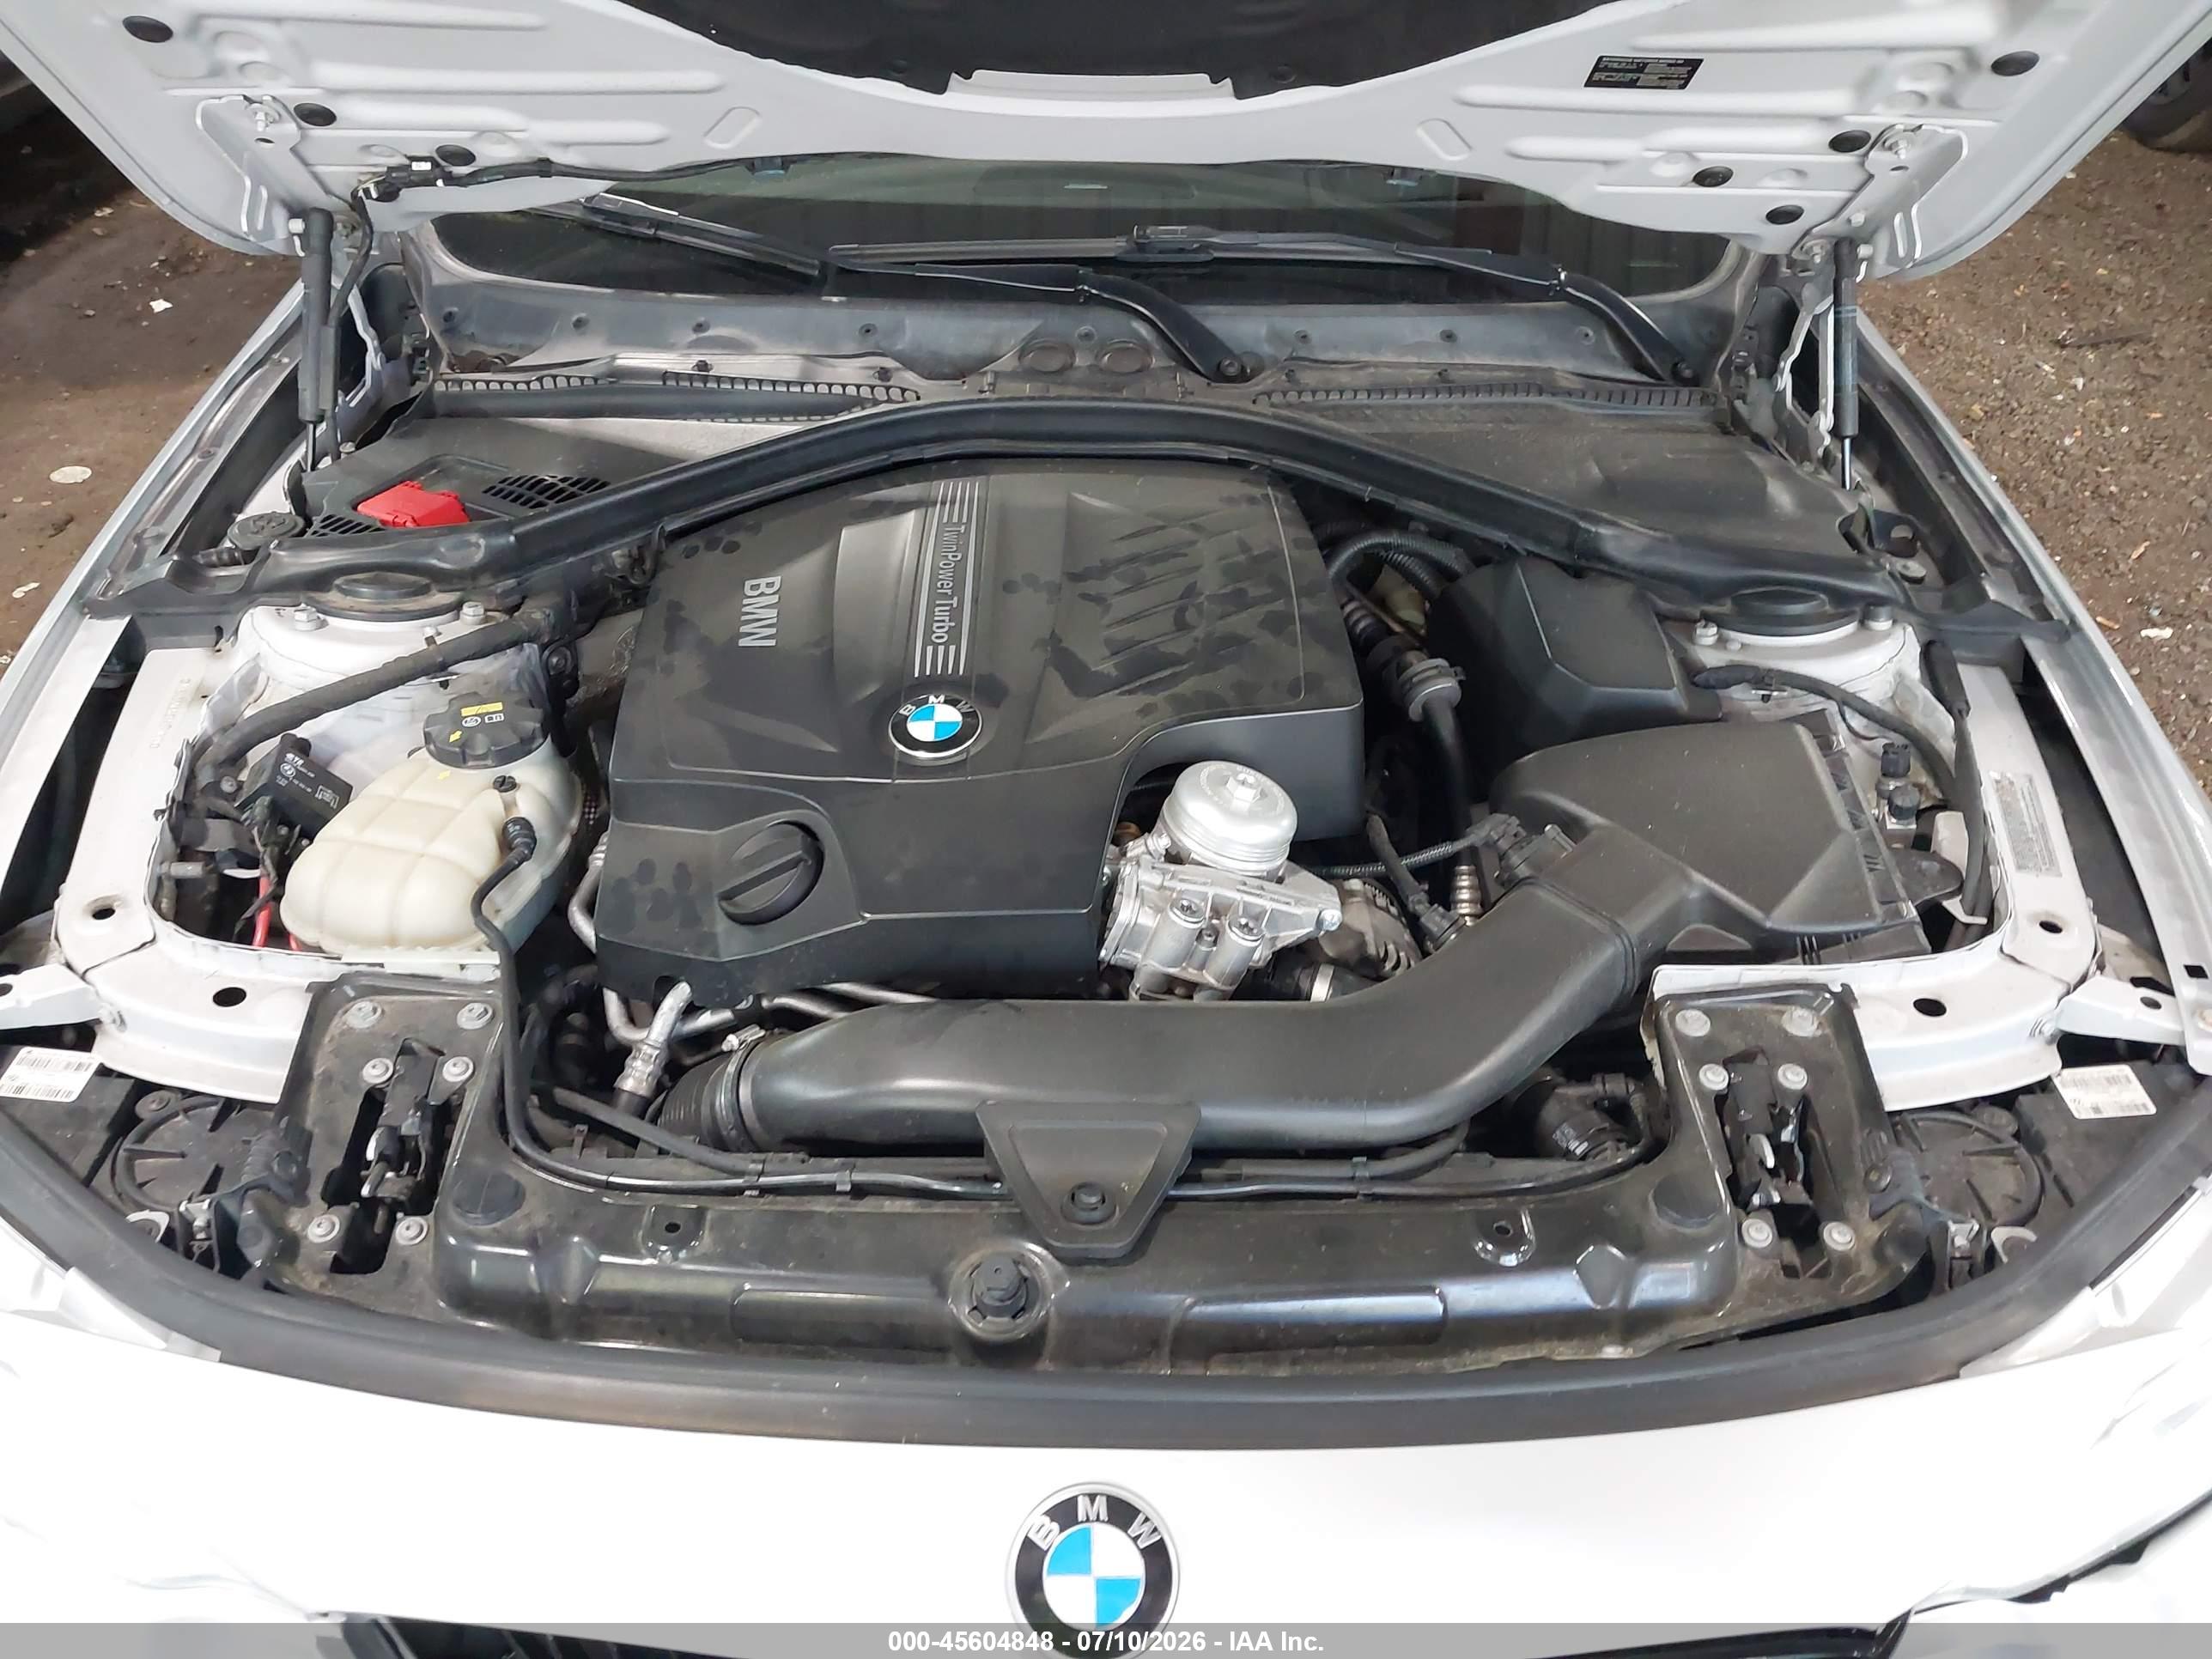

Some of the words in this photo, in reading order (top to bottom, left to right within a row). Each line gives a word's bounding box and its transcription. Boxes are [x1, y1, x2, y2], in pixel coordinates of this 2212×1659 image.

[936, 523, 965, 594] TwinPower
[738, 575, 782, 647] BMW
[932, 598, 962, 643] Turbo
[899, 694, 975, 716] BMW
[1028, 1495, 1162, 1551] BMW
